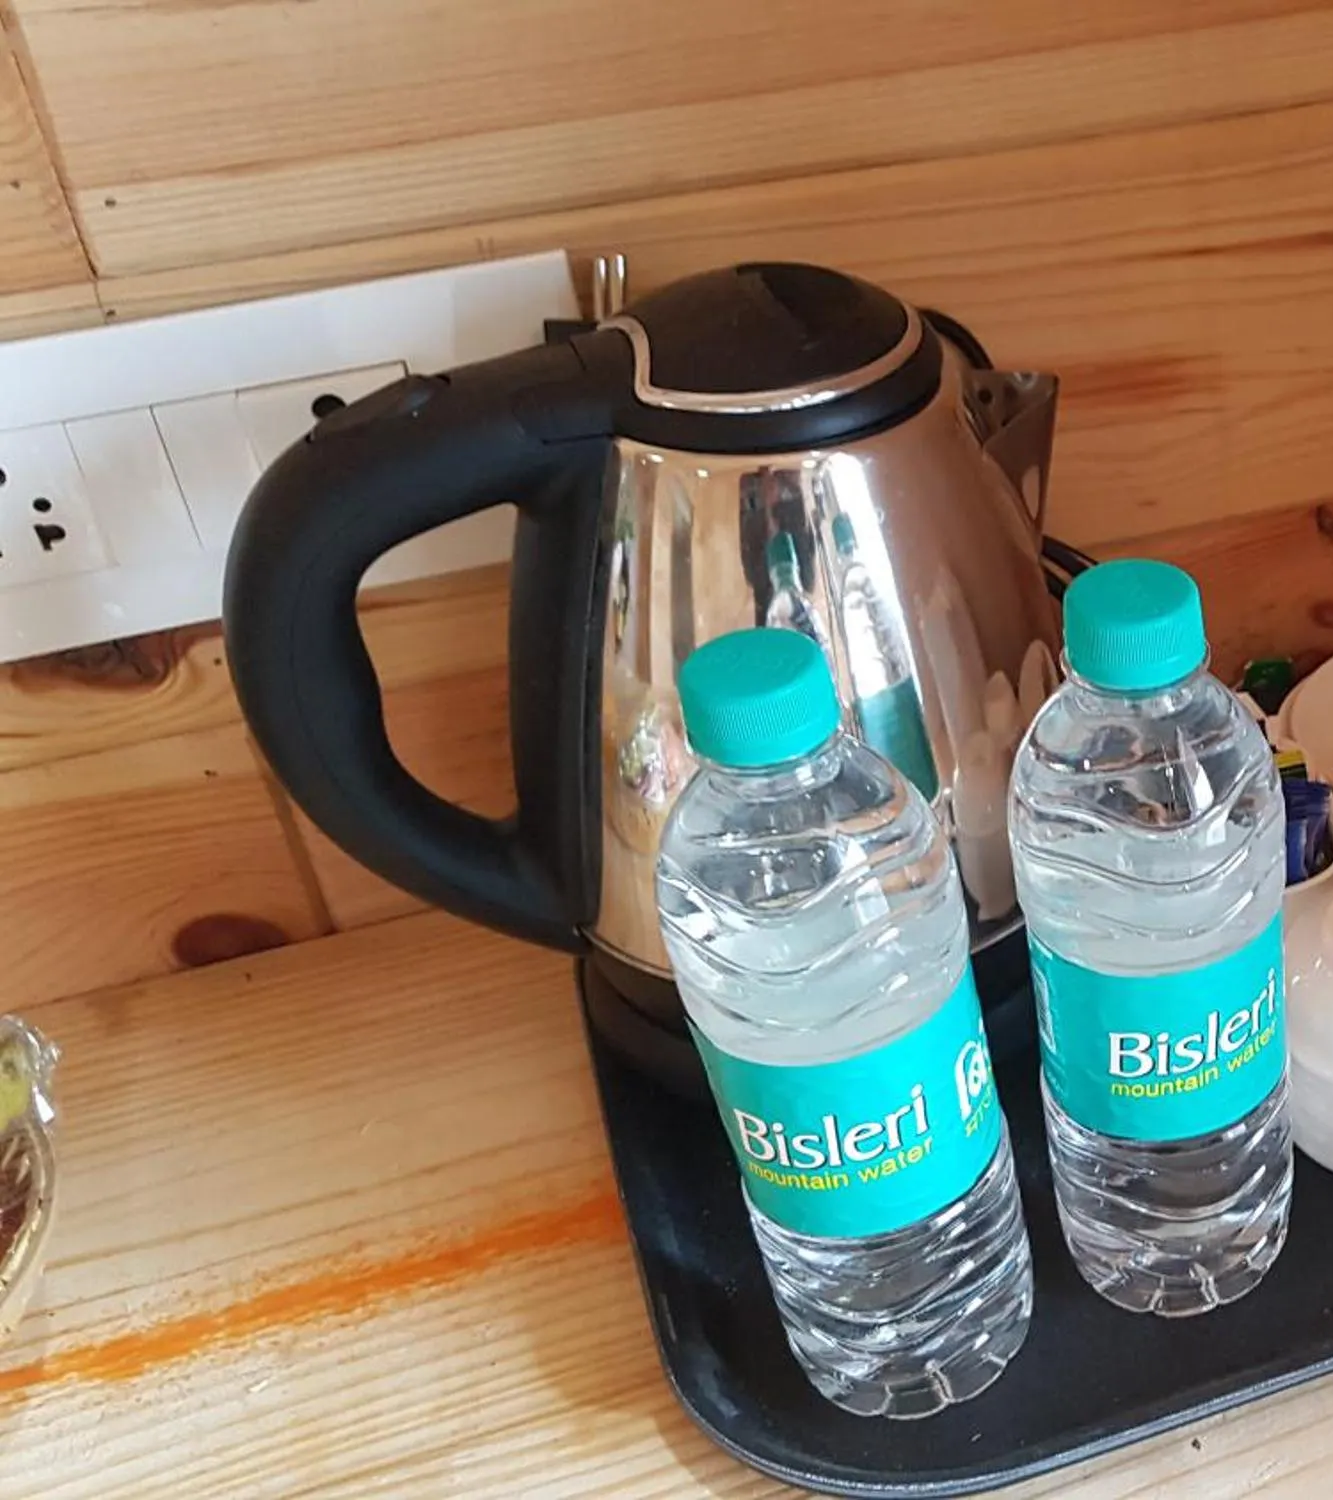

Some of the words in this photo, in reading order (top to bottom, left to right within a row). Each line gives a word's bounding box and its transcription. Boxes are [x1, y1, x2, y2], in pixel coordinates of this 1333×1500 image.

[1108, 967, 1277, 1079] Bisleri
[1110, 1065, 1220, 1099] mountain
[732, 1083, 931, 1171] Bisleri
[748, 1160, 849, 1191] mountain
[857, 1136, 934, 1184] water
